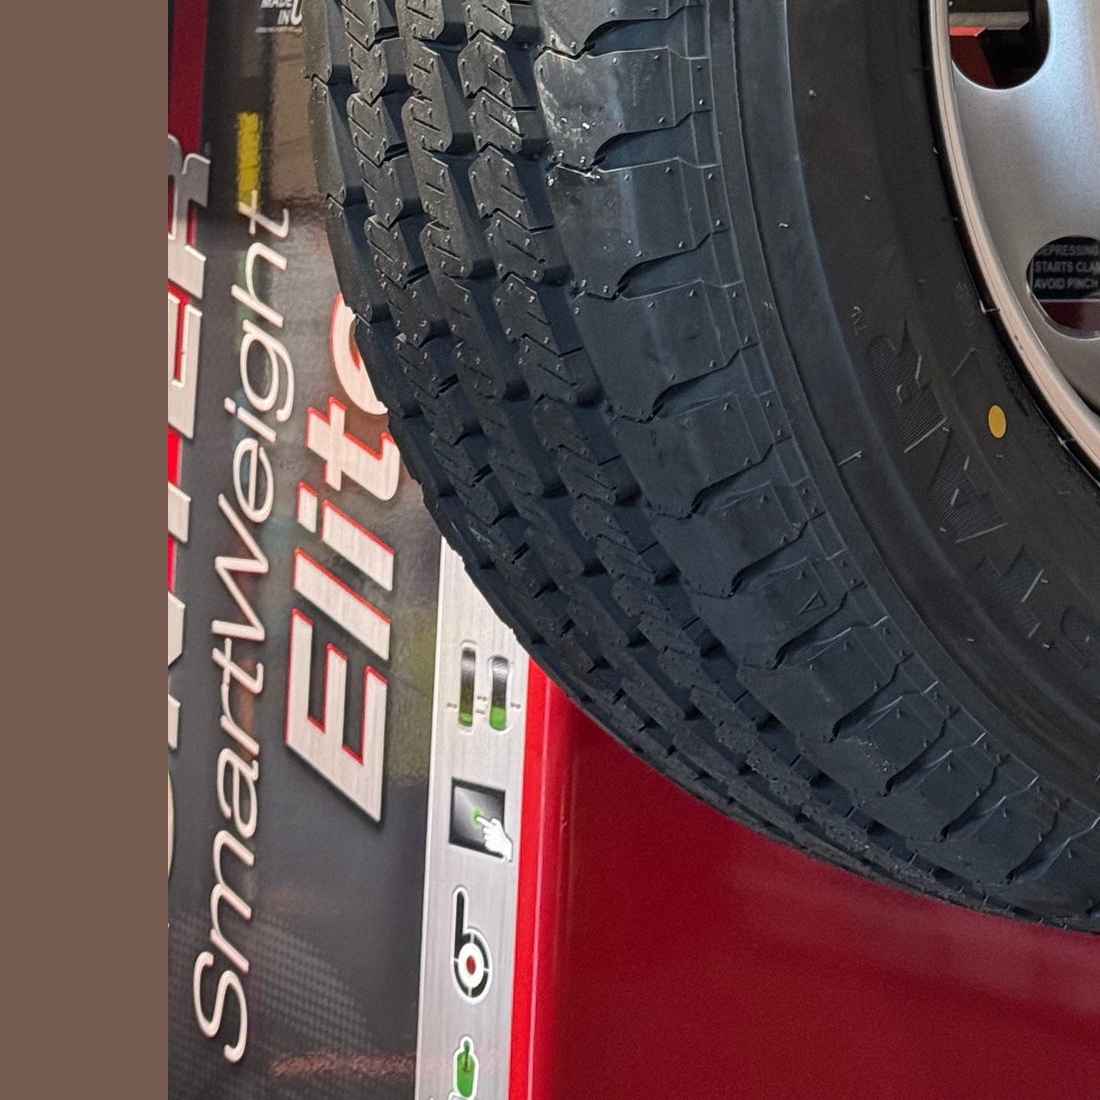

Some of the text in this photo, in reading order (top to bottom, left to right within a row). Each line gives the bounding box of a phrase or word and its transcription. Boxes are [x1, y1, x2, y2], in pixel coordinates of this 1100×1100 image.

[277, 9, 290, 25] IN
[1034, 261, 1074, 273] STARTS
[1034, 277, 1065, 289] AVOID
[193, 190, 295, 1063] SmartWeight
